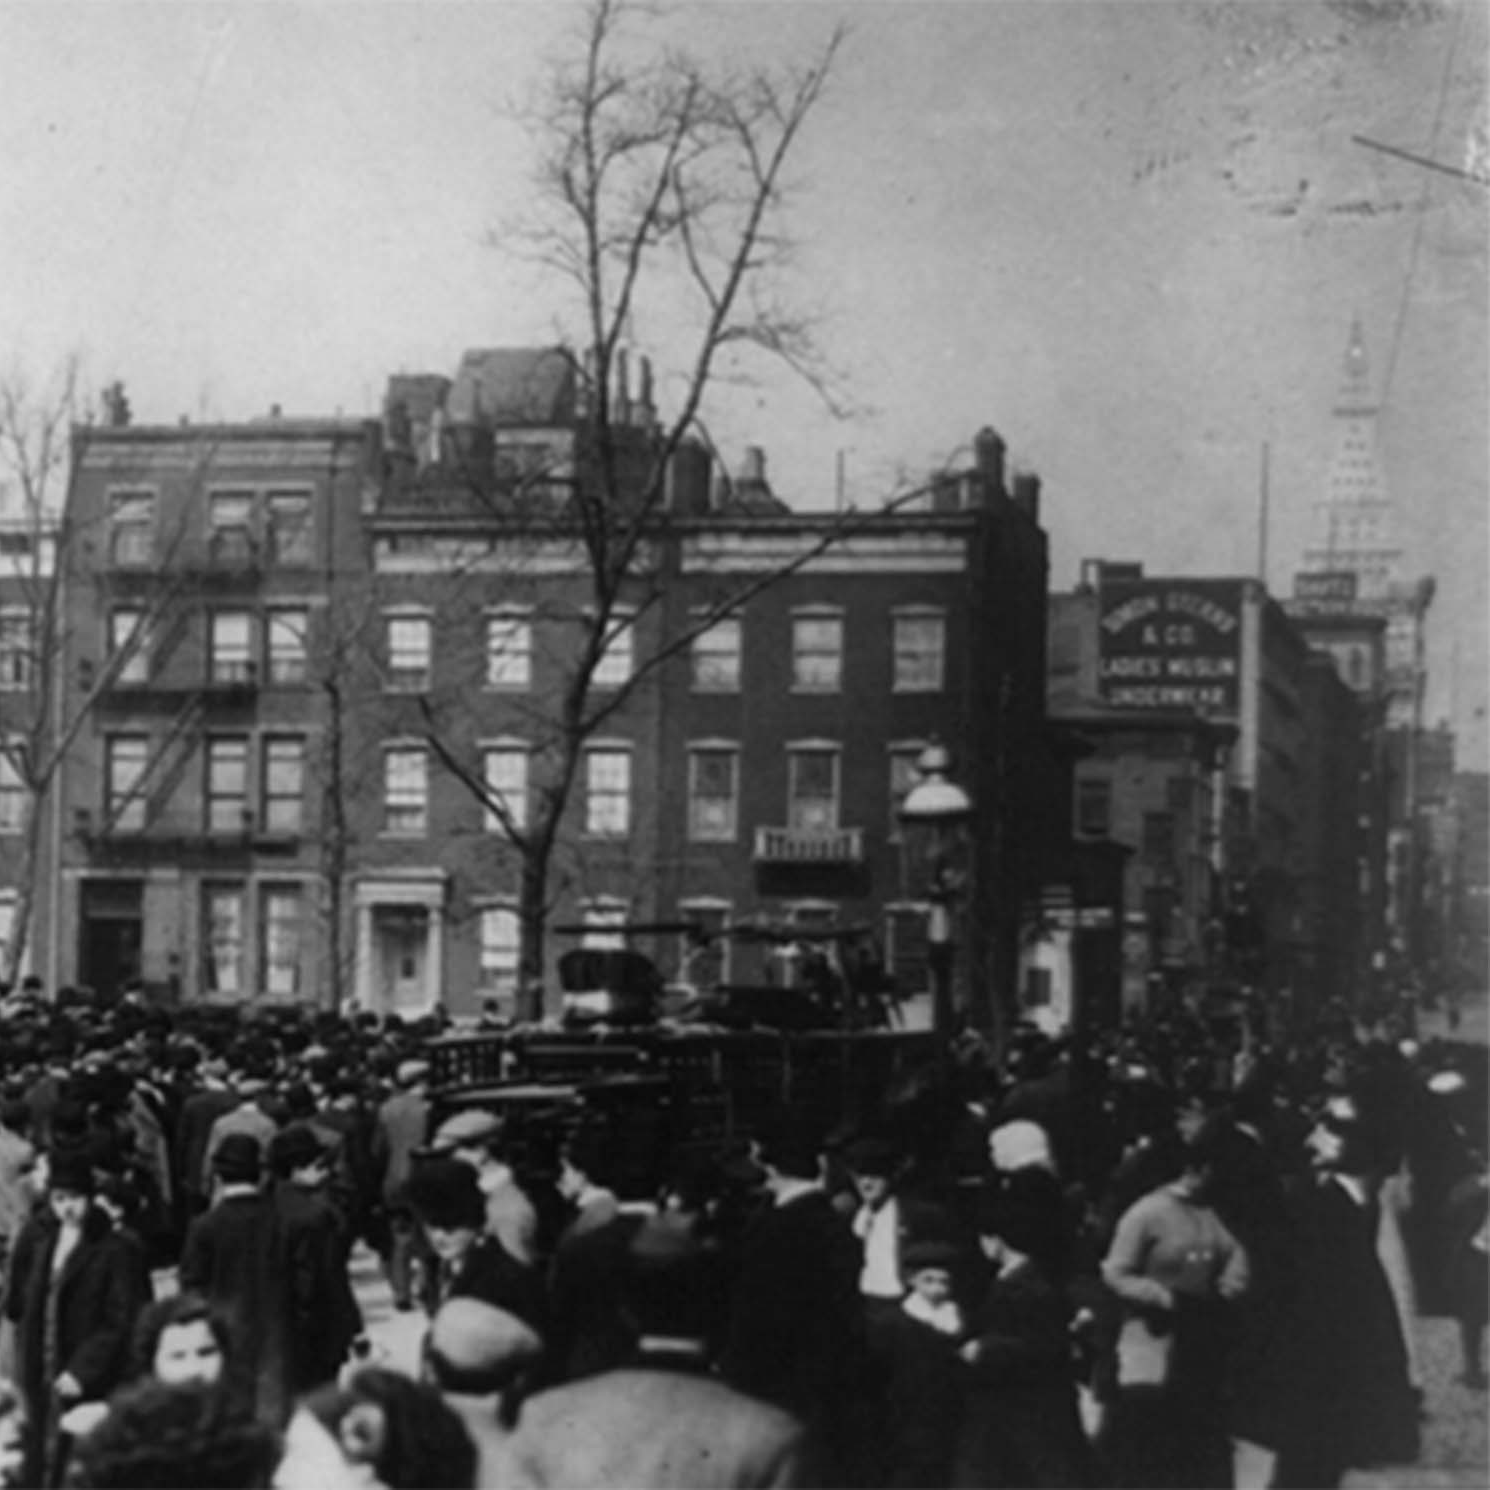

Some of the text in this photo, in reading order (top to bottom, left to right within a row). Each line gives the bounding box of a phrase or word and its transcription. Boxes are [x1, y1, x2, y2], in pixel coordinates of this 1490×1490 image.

[1101, 596, 1158, 632] SIMON
[1143, 625, 1158, 644] &
[1168, 657, 1235, 677] MUSLIN
[1110, 686, 1225, 704] UNDERWEAR
